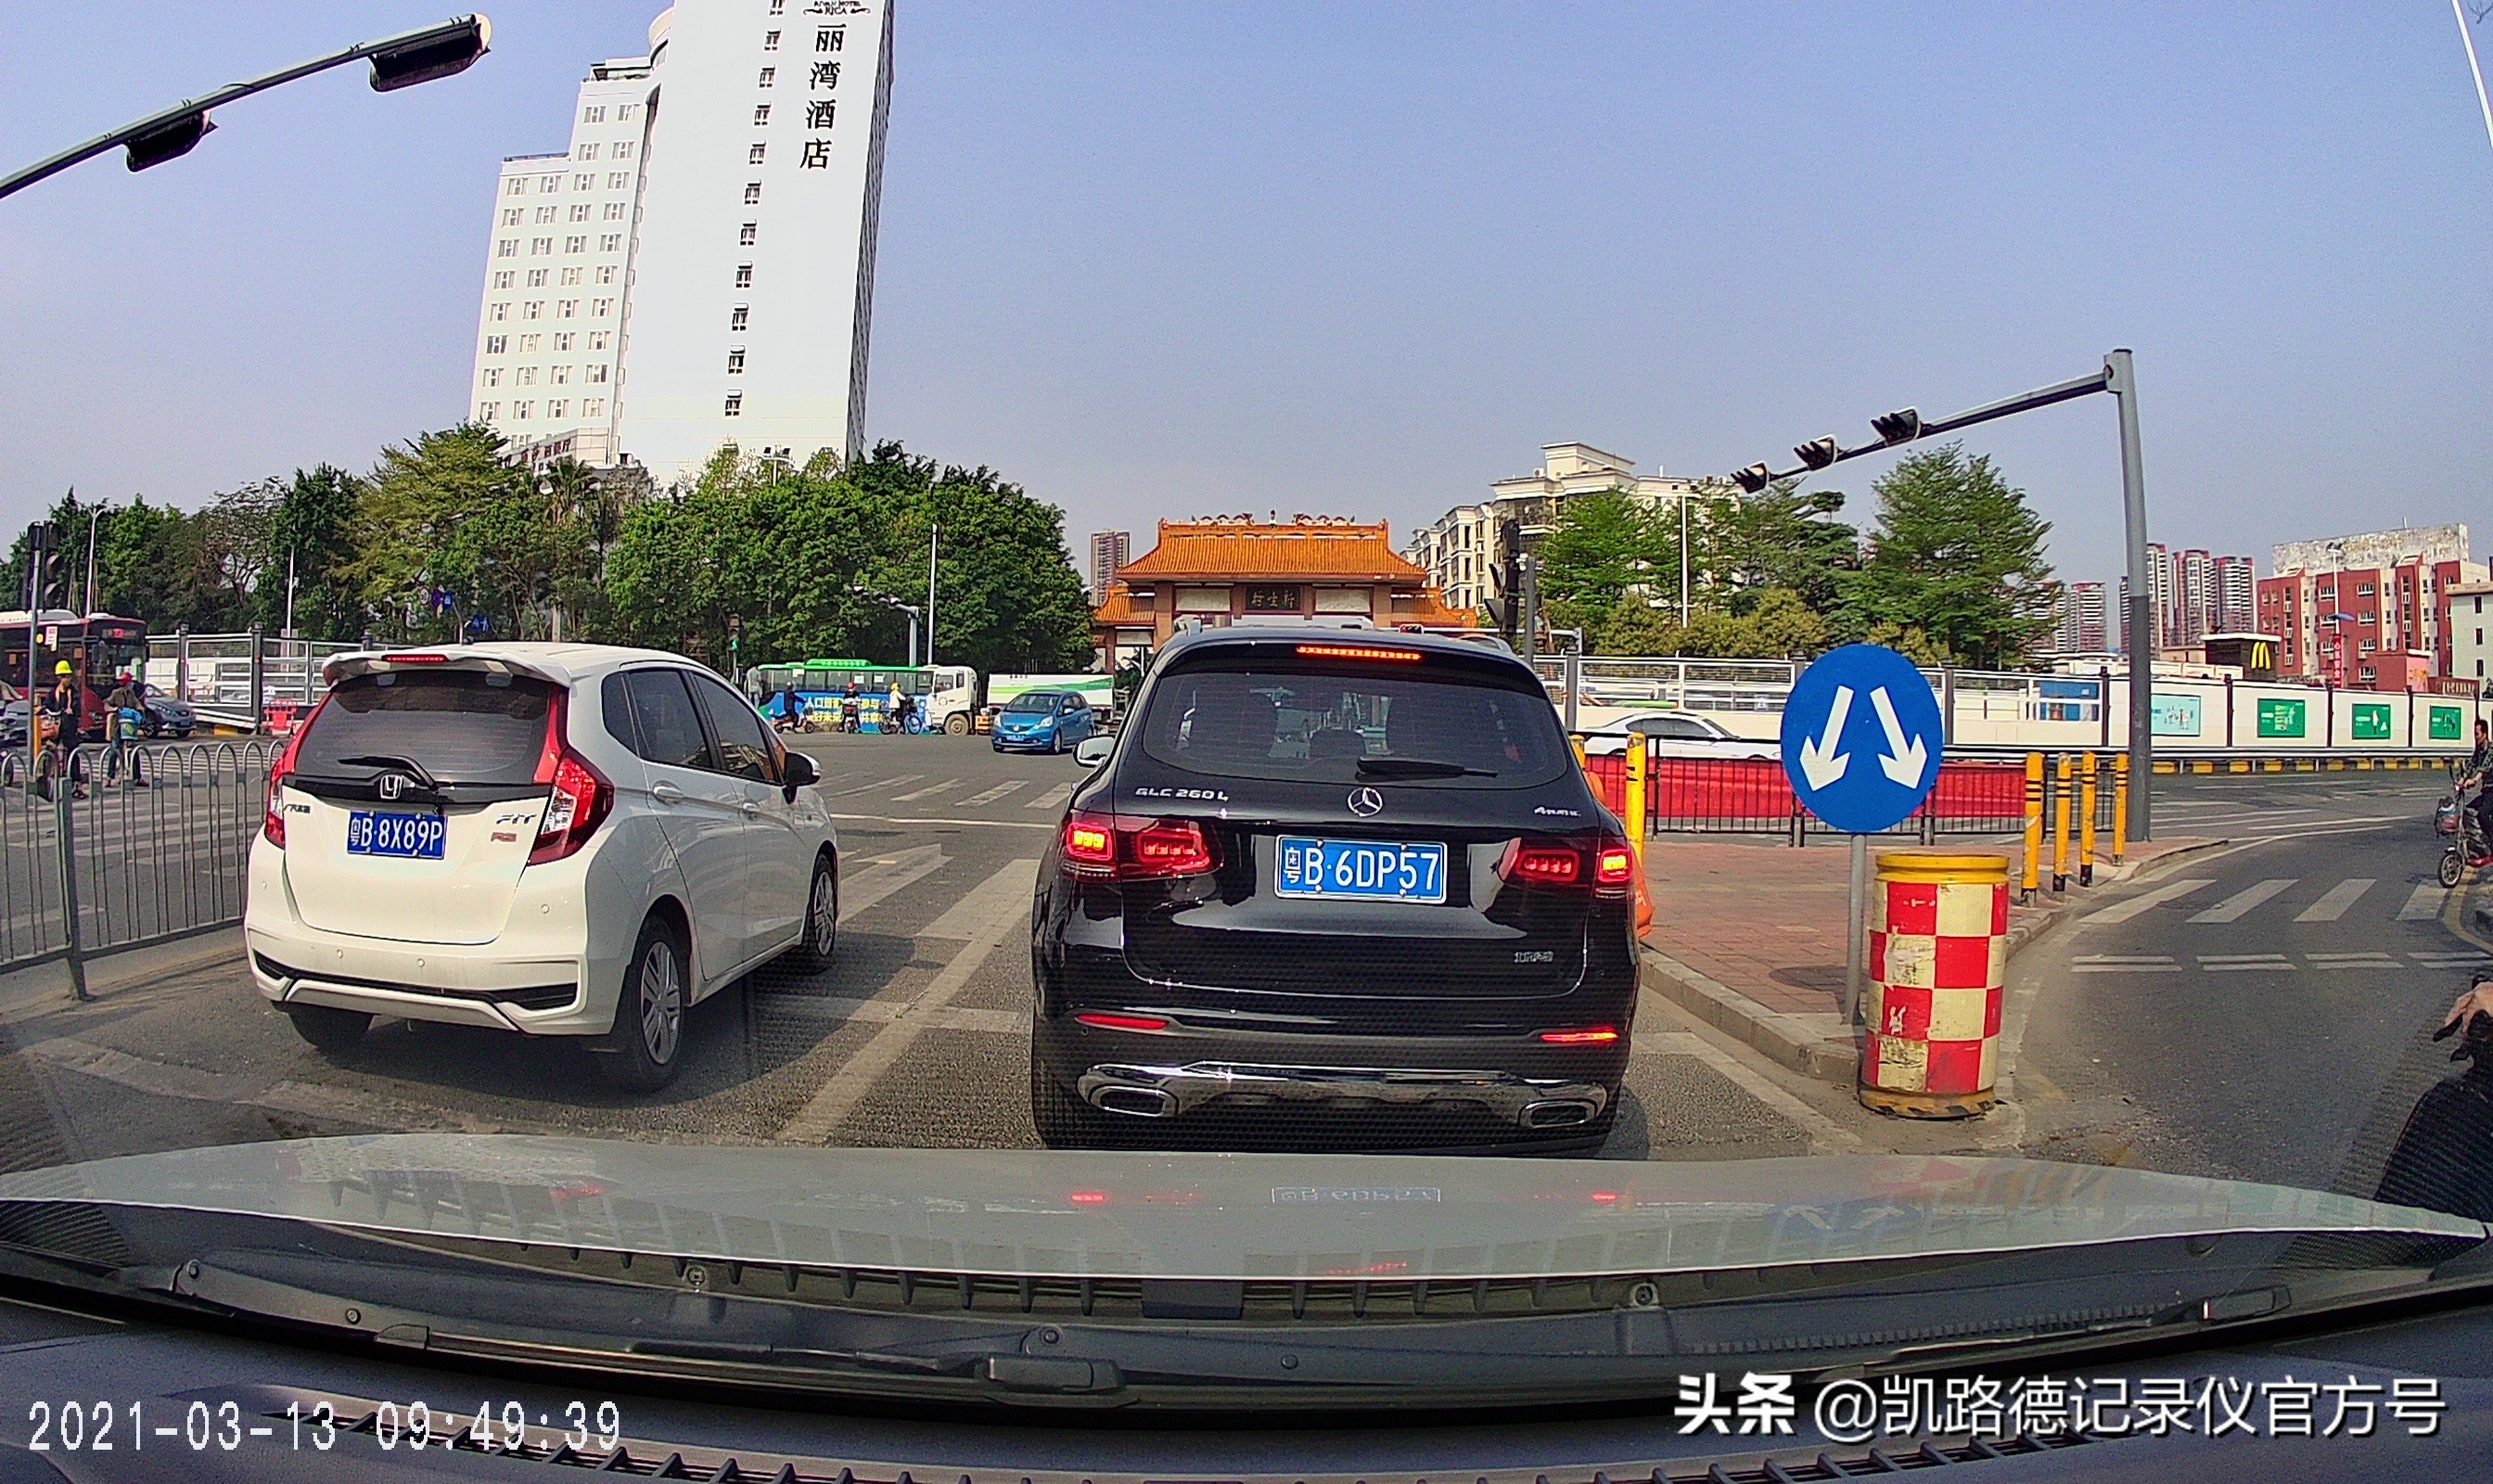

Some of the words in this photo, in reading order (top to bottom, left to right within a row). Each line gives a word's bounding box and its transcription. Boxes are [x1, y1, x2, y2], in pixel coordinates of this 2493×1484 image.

[799, 23, 848, 170] 丽湾酒店
[1135, 787, 1172, 797] GLC
[1175, 788, 1215, 800] 260
[496, 813, 537, 825] FIT
